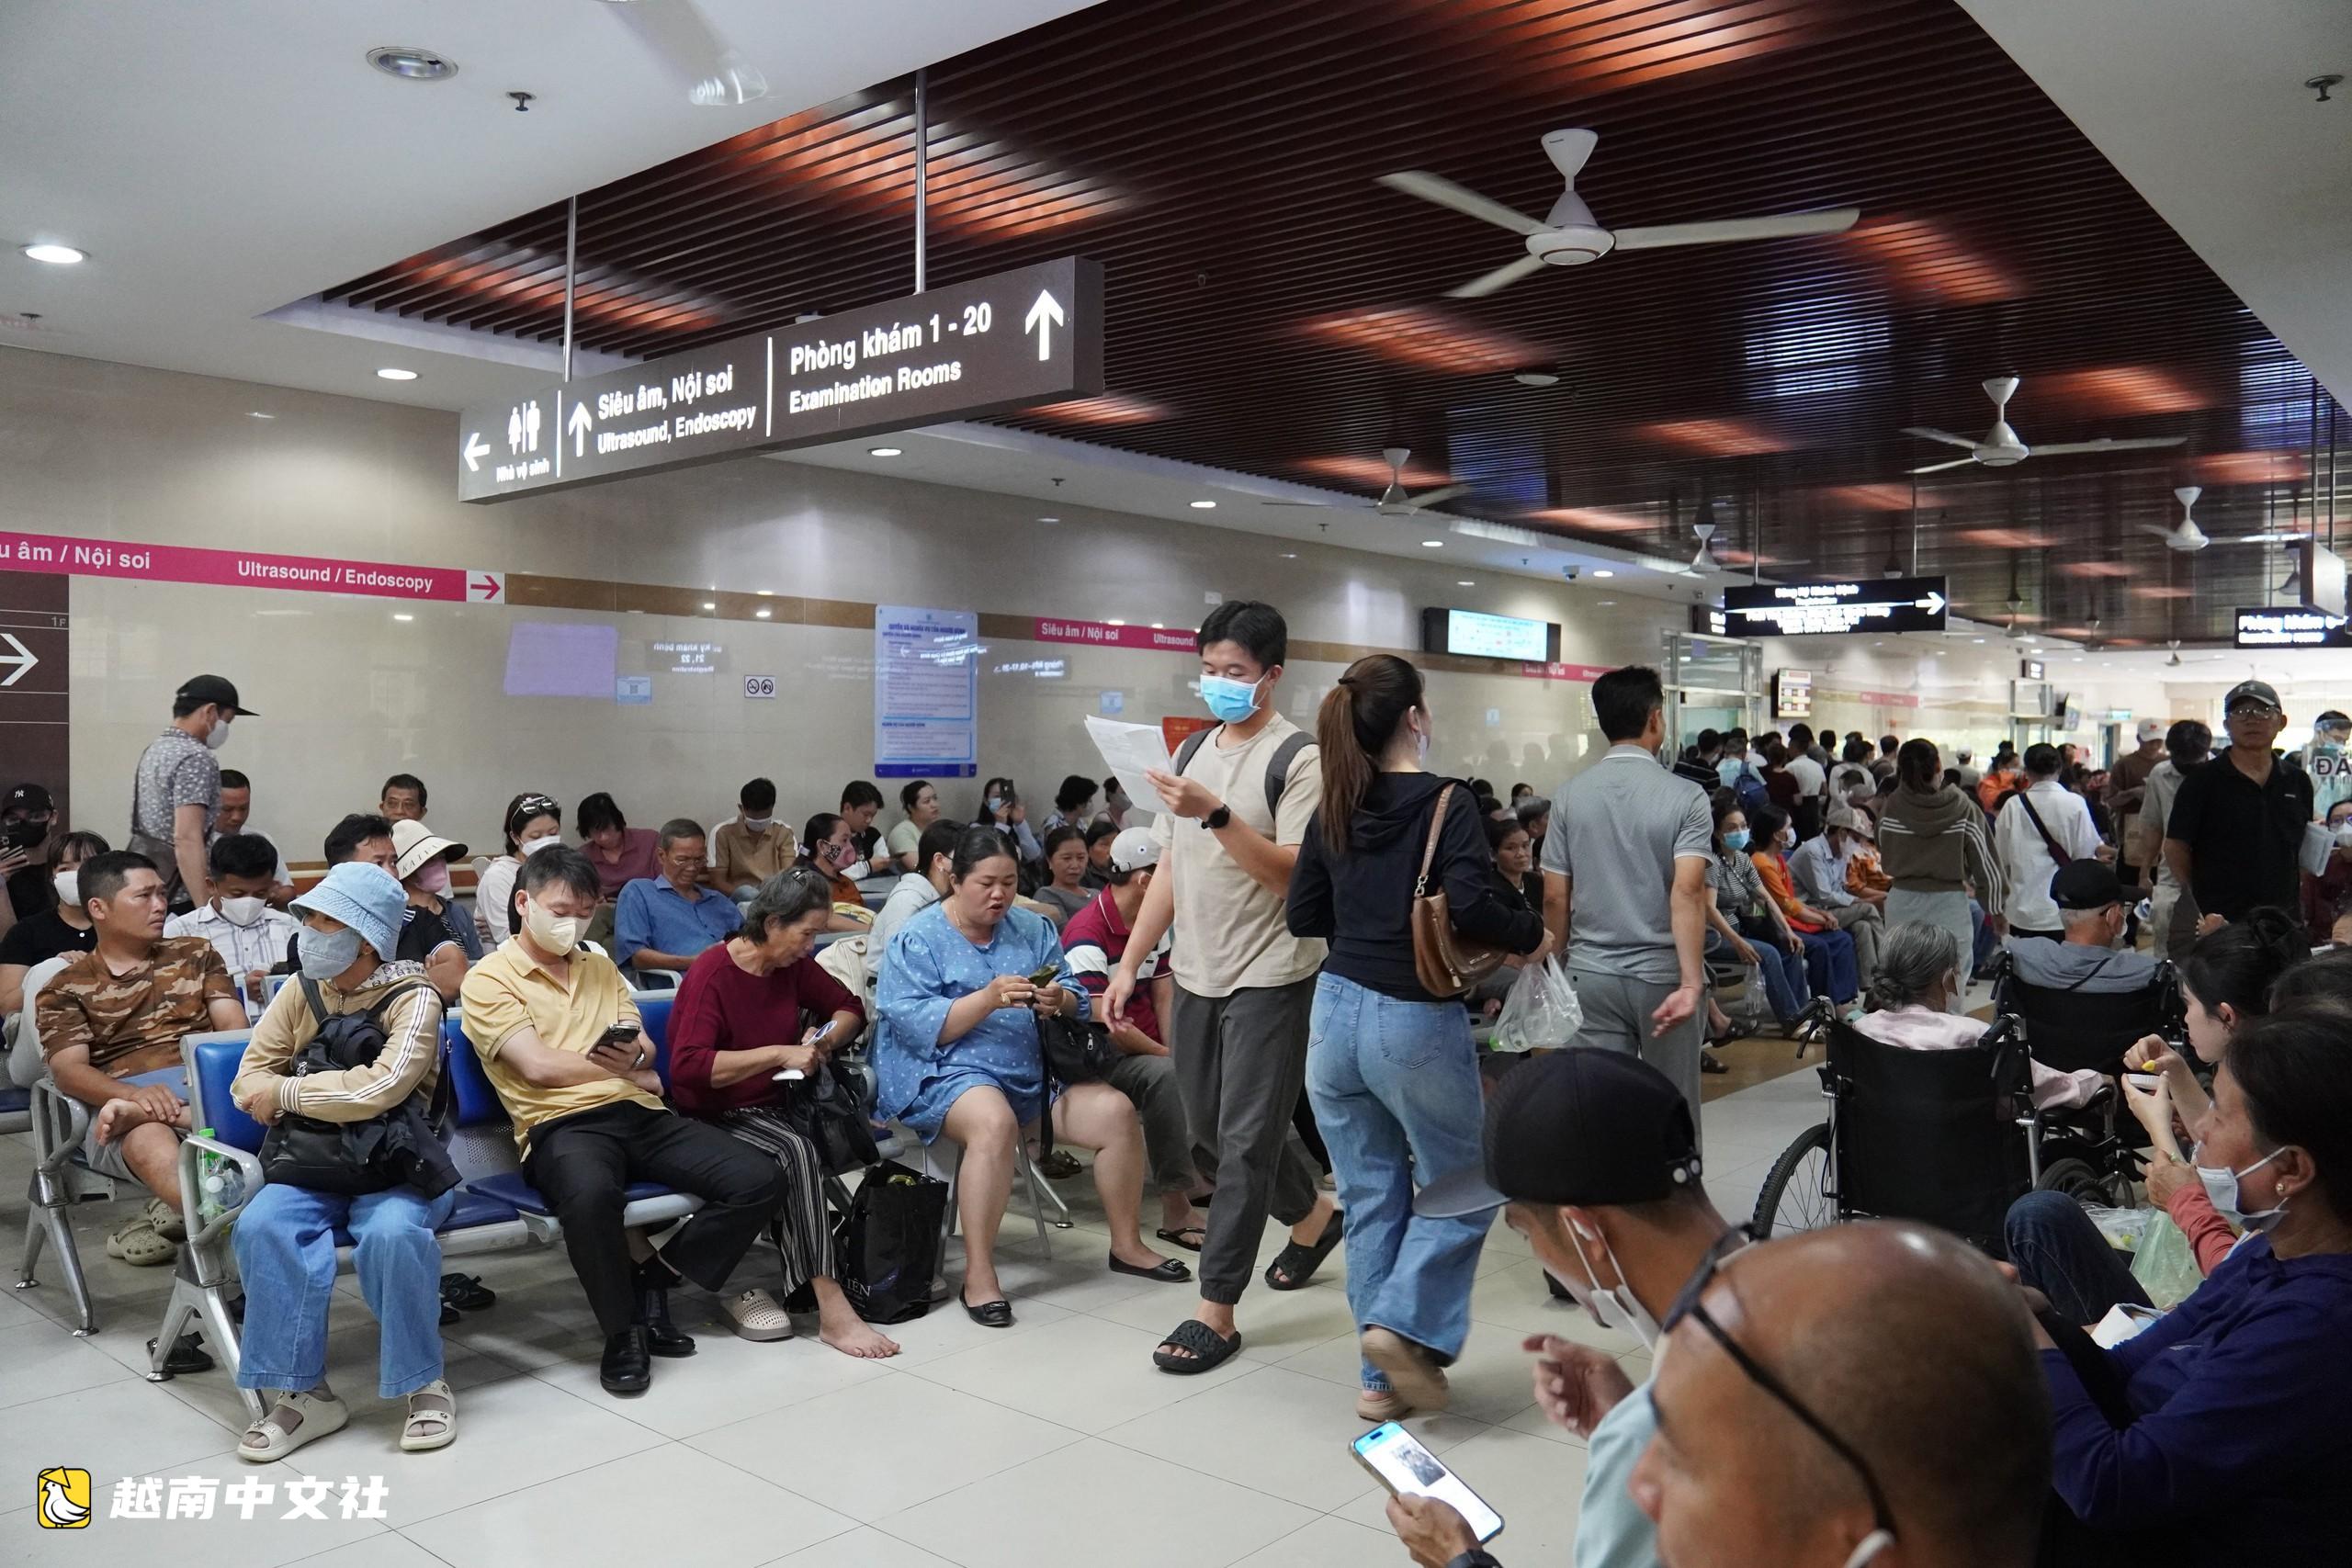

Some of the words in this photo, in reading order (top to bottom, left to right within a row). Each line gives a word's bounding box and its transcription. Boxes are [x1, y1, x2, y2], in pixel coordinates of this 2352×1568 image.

[791, 340, 855, 375] Phòng
[864, 322, 922, 358] khám
[930, 314, 940, 343] 1
[964, 302, 991, 335] 20
[598, 390, 634, 420] Siêu
[637, 385, 667, 411] âm,
[673, 372, 702, 404] Nội
[706, 365, 733, 395] soi
[790, 375, 892, 413] Examination
[898, 361, 961, 392] Rooms
[598, 420, 672, 454] Ultrasound,
[675, 406, 757, 439] Endoscopy
[17, 541, 52, 562] âm
[74, 546, 112, 570] Nội
[119, 551, 151, 570] soi
[237, 560, 331, 582] Ultrasound
[345, 569, 434, 593] Endoscopy
[51, 615, 66, 626] 1F
[1041, 622, 1063, 636] Siêu
[1065, 625, 1080, 637] âm
[1087, 626, 1102, 641] Nội
[1104, 629, 1119, 641] soi
[1153, 633, 1194, 647] Ultrasound
[845, 1278, 872, 1298] IÊN
